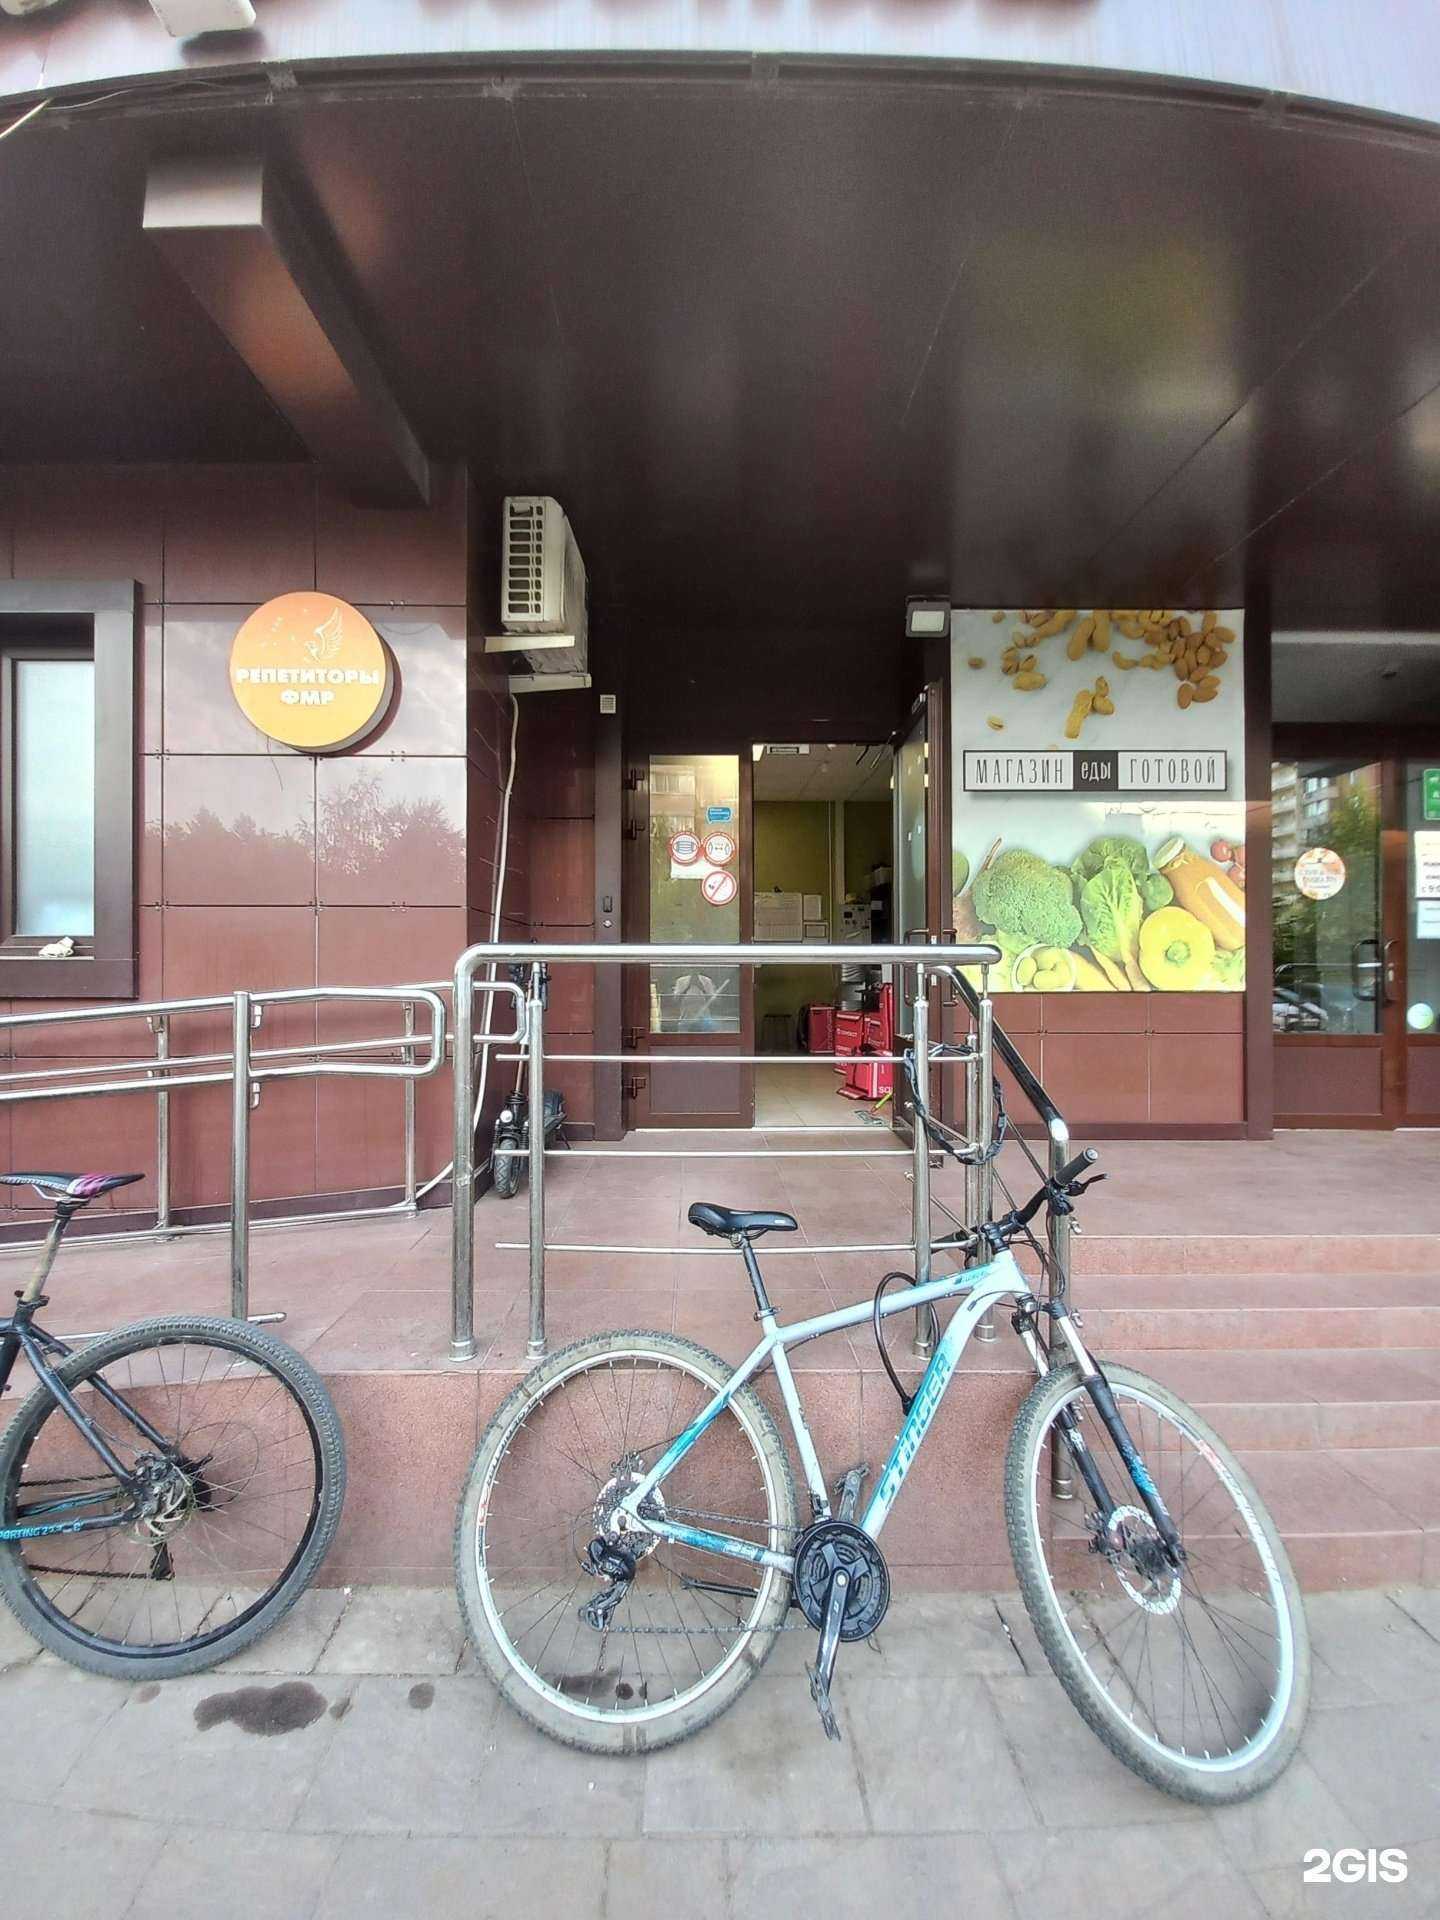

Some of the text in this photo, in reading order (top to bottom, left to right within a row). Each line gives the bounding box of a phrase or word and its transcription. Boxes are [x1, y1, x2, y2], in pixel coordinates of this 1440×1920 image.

[235, 667, 380, 684] РЕПЕТИТОРЫ
[280, 689, 335, 705] ФМР
[975, 756, 1216, 784] МАГАЗИН еды ГОТОВОЙ
